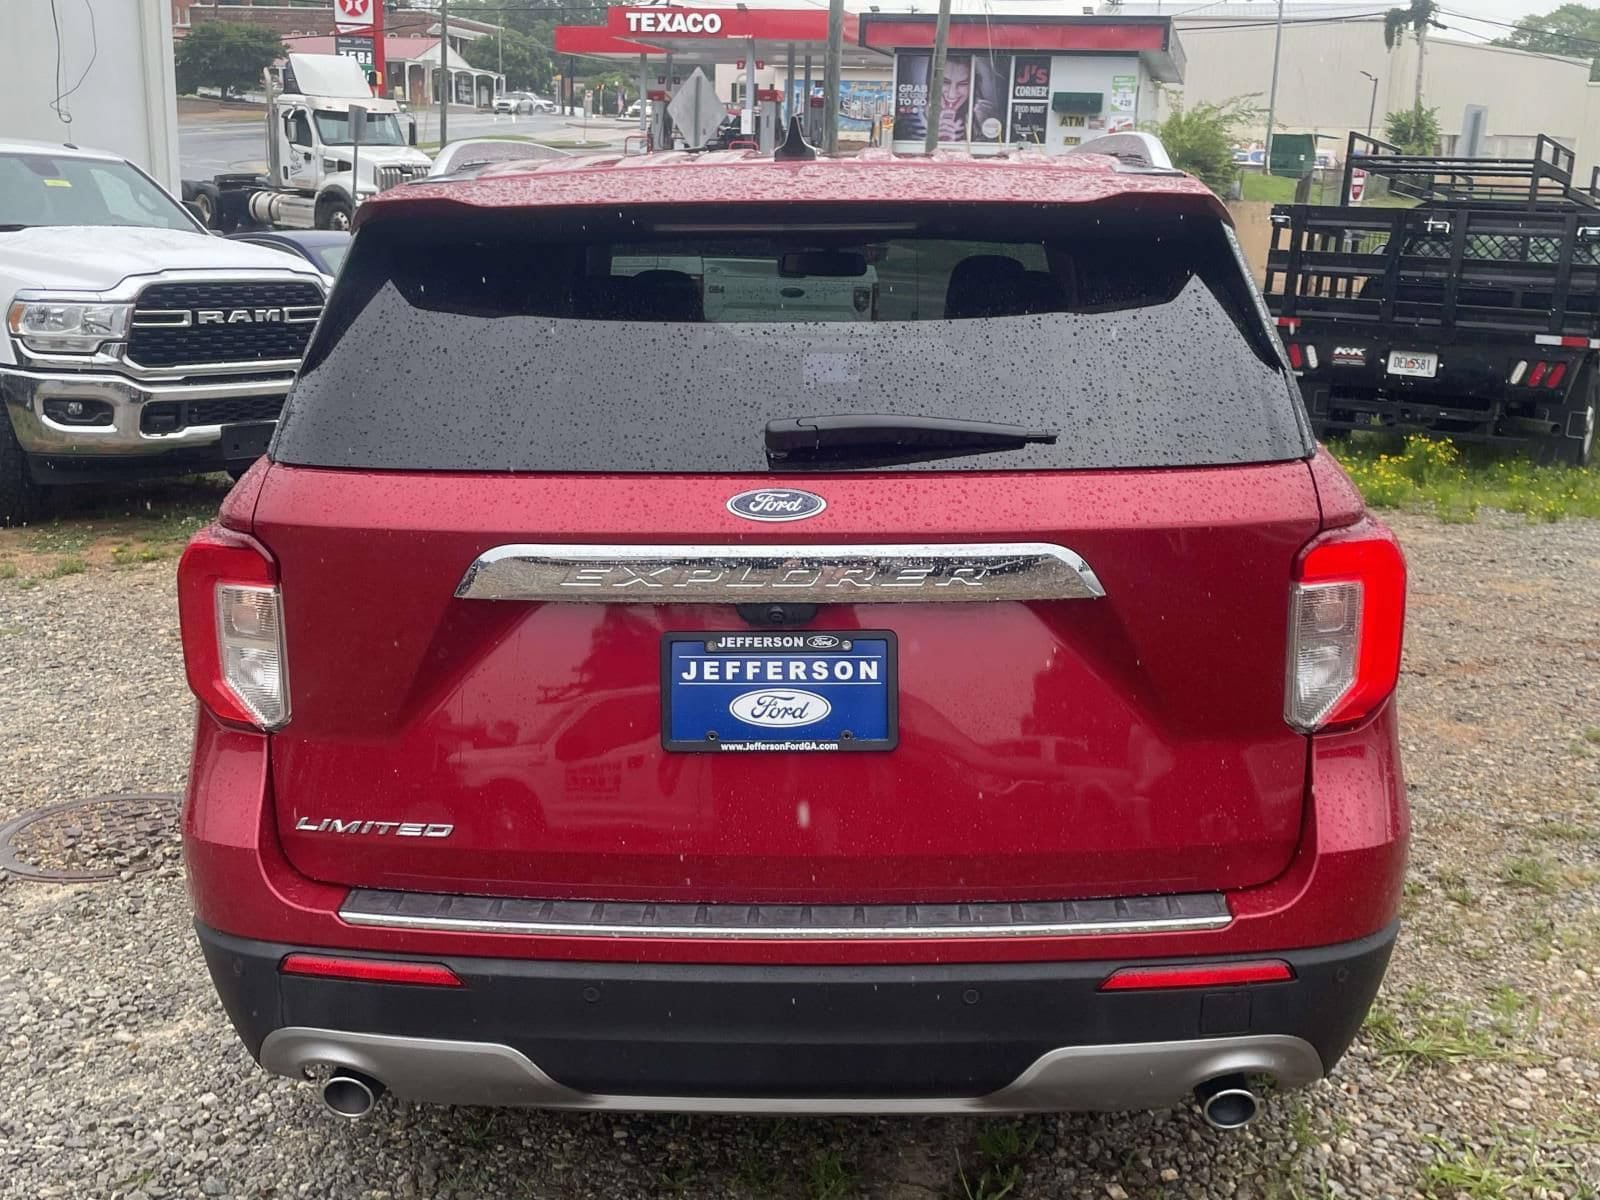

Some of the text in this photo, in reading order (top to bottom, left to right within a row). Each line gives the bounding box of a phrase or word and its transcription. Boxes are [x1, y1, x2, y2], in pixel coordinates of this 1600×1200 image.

[625, 13, 722, 33] TEXACO
[899, 84, 928, 93] GRAB
[1014, 86, 1048, 97] CORNER
[899, 98, 927, 106] TO GO
[1060, 116, 1085, 128] ATM
[1064, 136, 1081, 145] ATM
[198, 309, 281, 324] RAM
[749, 493, 803, 511] Ford
[560, 566, 989, 588] EXPLORER
[717, 637, 834, 648] JEFFERSON Ford
[681, 660, 878, 681] JEFFERSON
[750, 694, 810, 720] Ford
[720, 741, 839, 751] www.JeffersonFordGA.com
[295, 816, 455, 838] LIMITED
